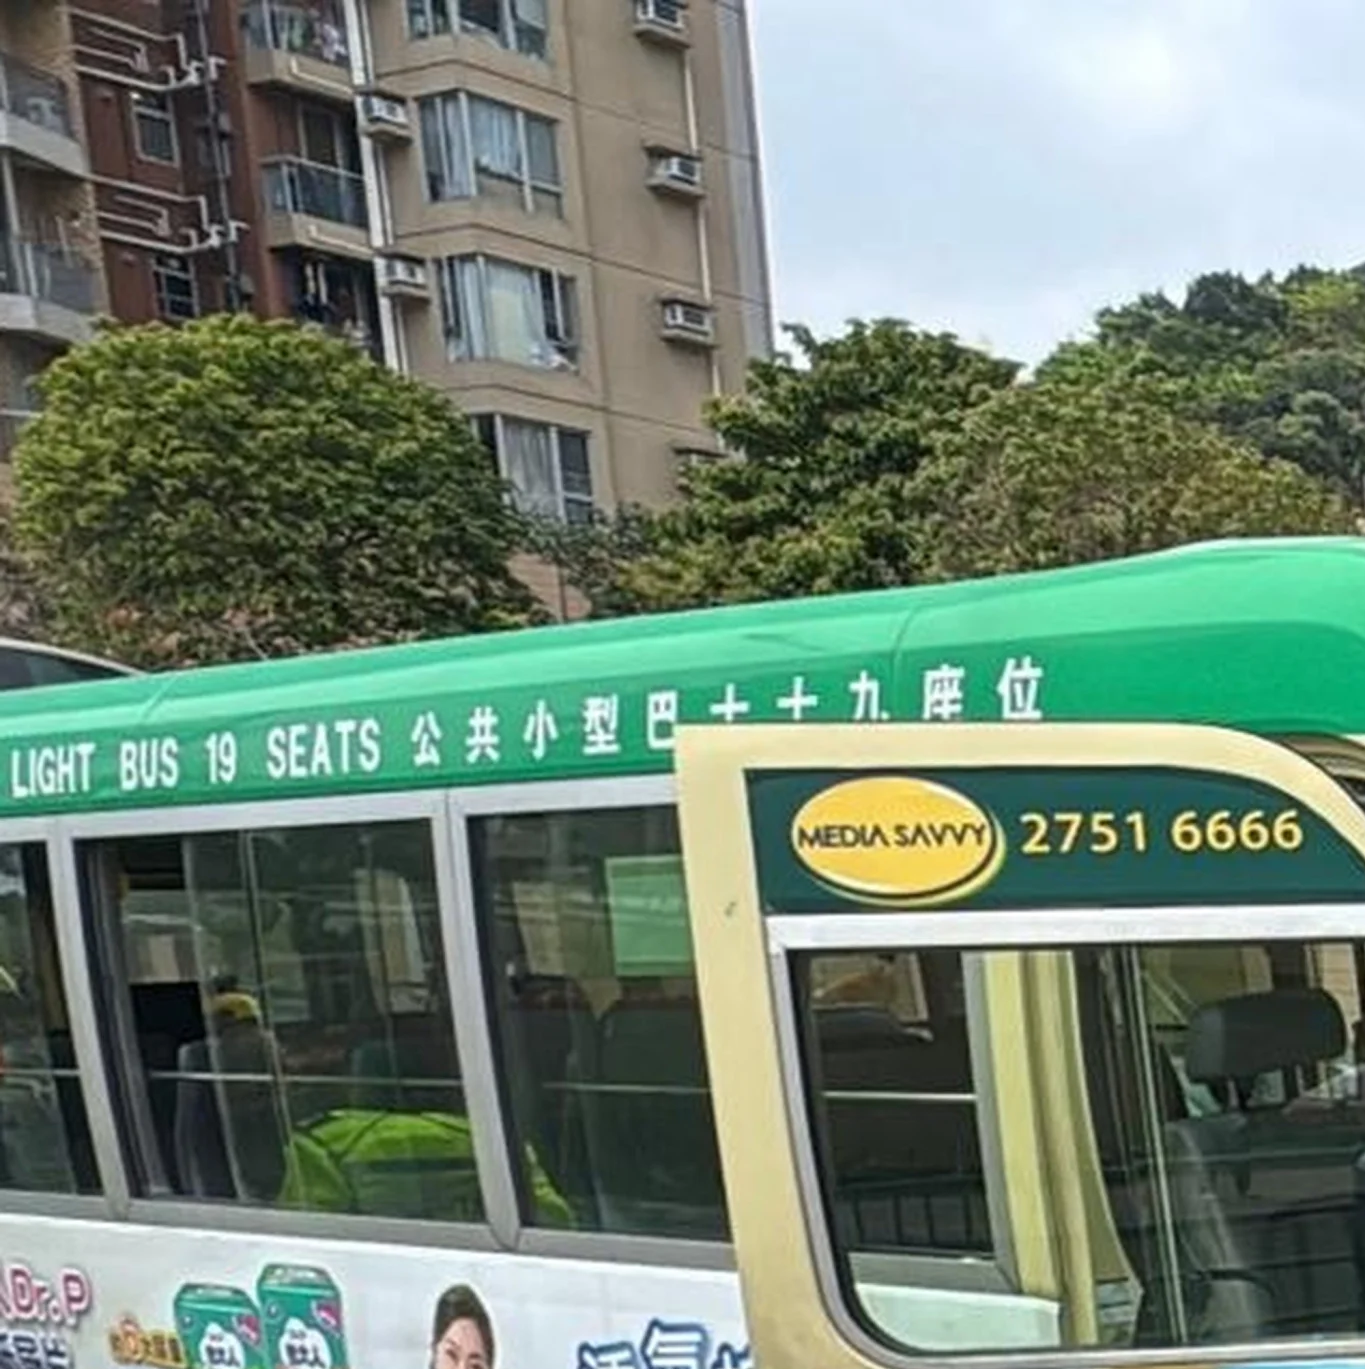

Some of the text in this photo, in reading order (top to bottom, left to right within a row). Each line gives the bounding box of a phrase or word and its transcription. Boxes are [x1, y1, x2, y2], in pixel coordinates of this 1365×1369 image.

[11, 742, 96, 798] LIGHT
[119, 737, 179, 791] BUS
[205, 731, 237, 783] 19
[266, 718, 381, 779] SEATS
[797, 823, 989, 848] MEDIA SAVVY
[1020, 809, 1304, 855] 2751 6666
